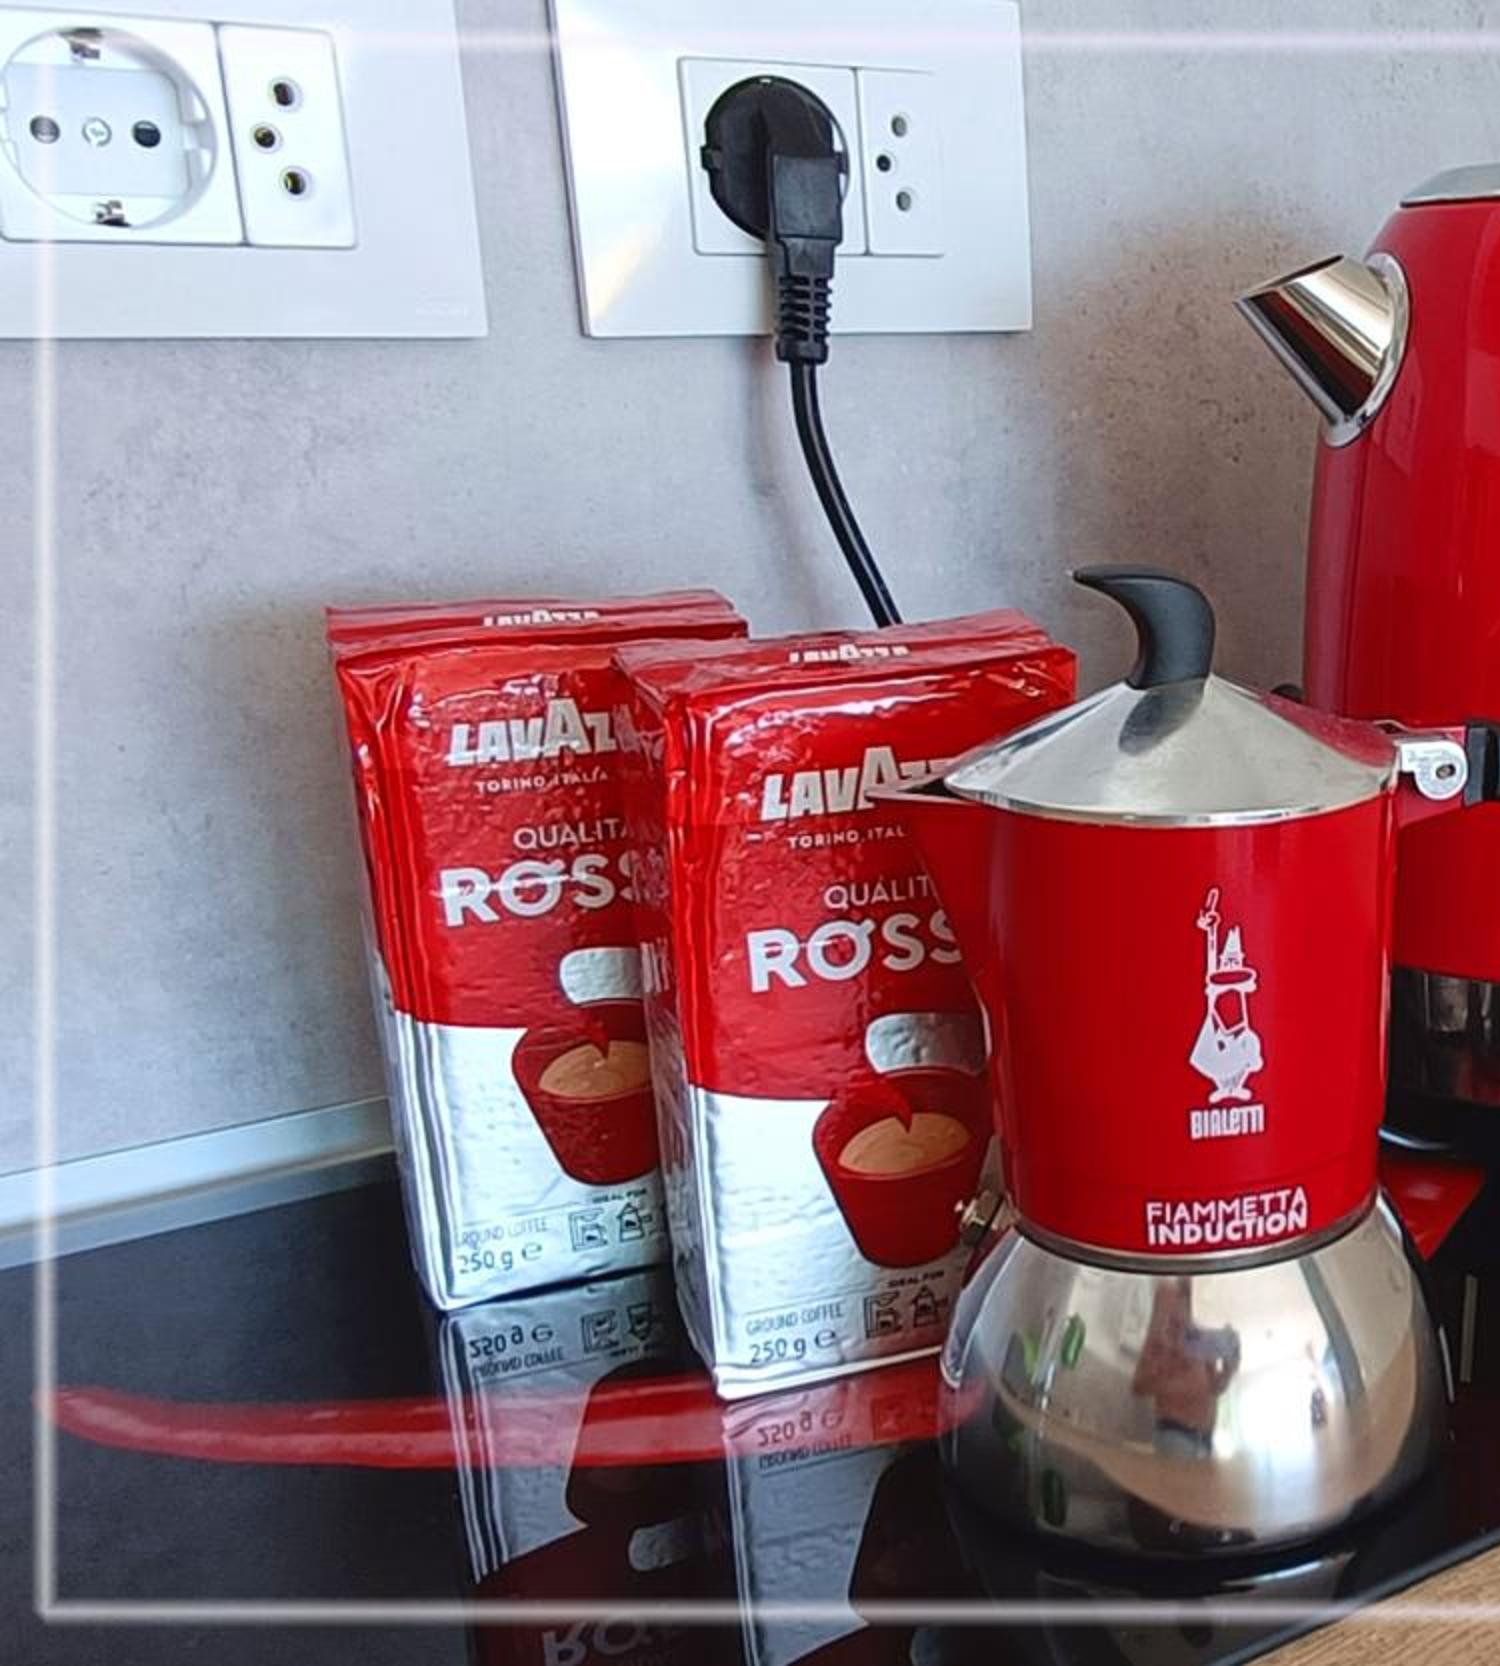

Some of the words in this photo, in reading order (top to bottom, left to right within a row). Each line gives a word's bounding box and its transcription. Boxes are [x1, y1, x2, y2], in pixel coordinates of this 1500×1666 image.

[1190, 1104, 1265, 1141] BIALETTI
[1146, 1186, 1307, 1223] FIAMMETTA
[1148, 1201, 1308, 1246] INDUCTION
[801, 1301, 845, 1323] COFFEE
[750, 1337, 788, 1364] 250
[792, 1337, 807, 1359] g
